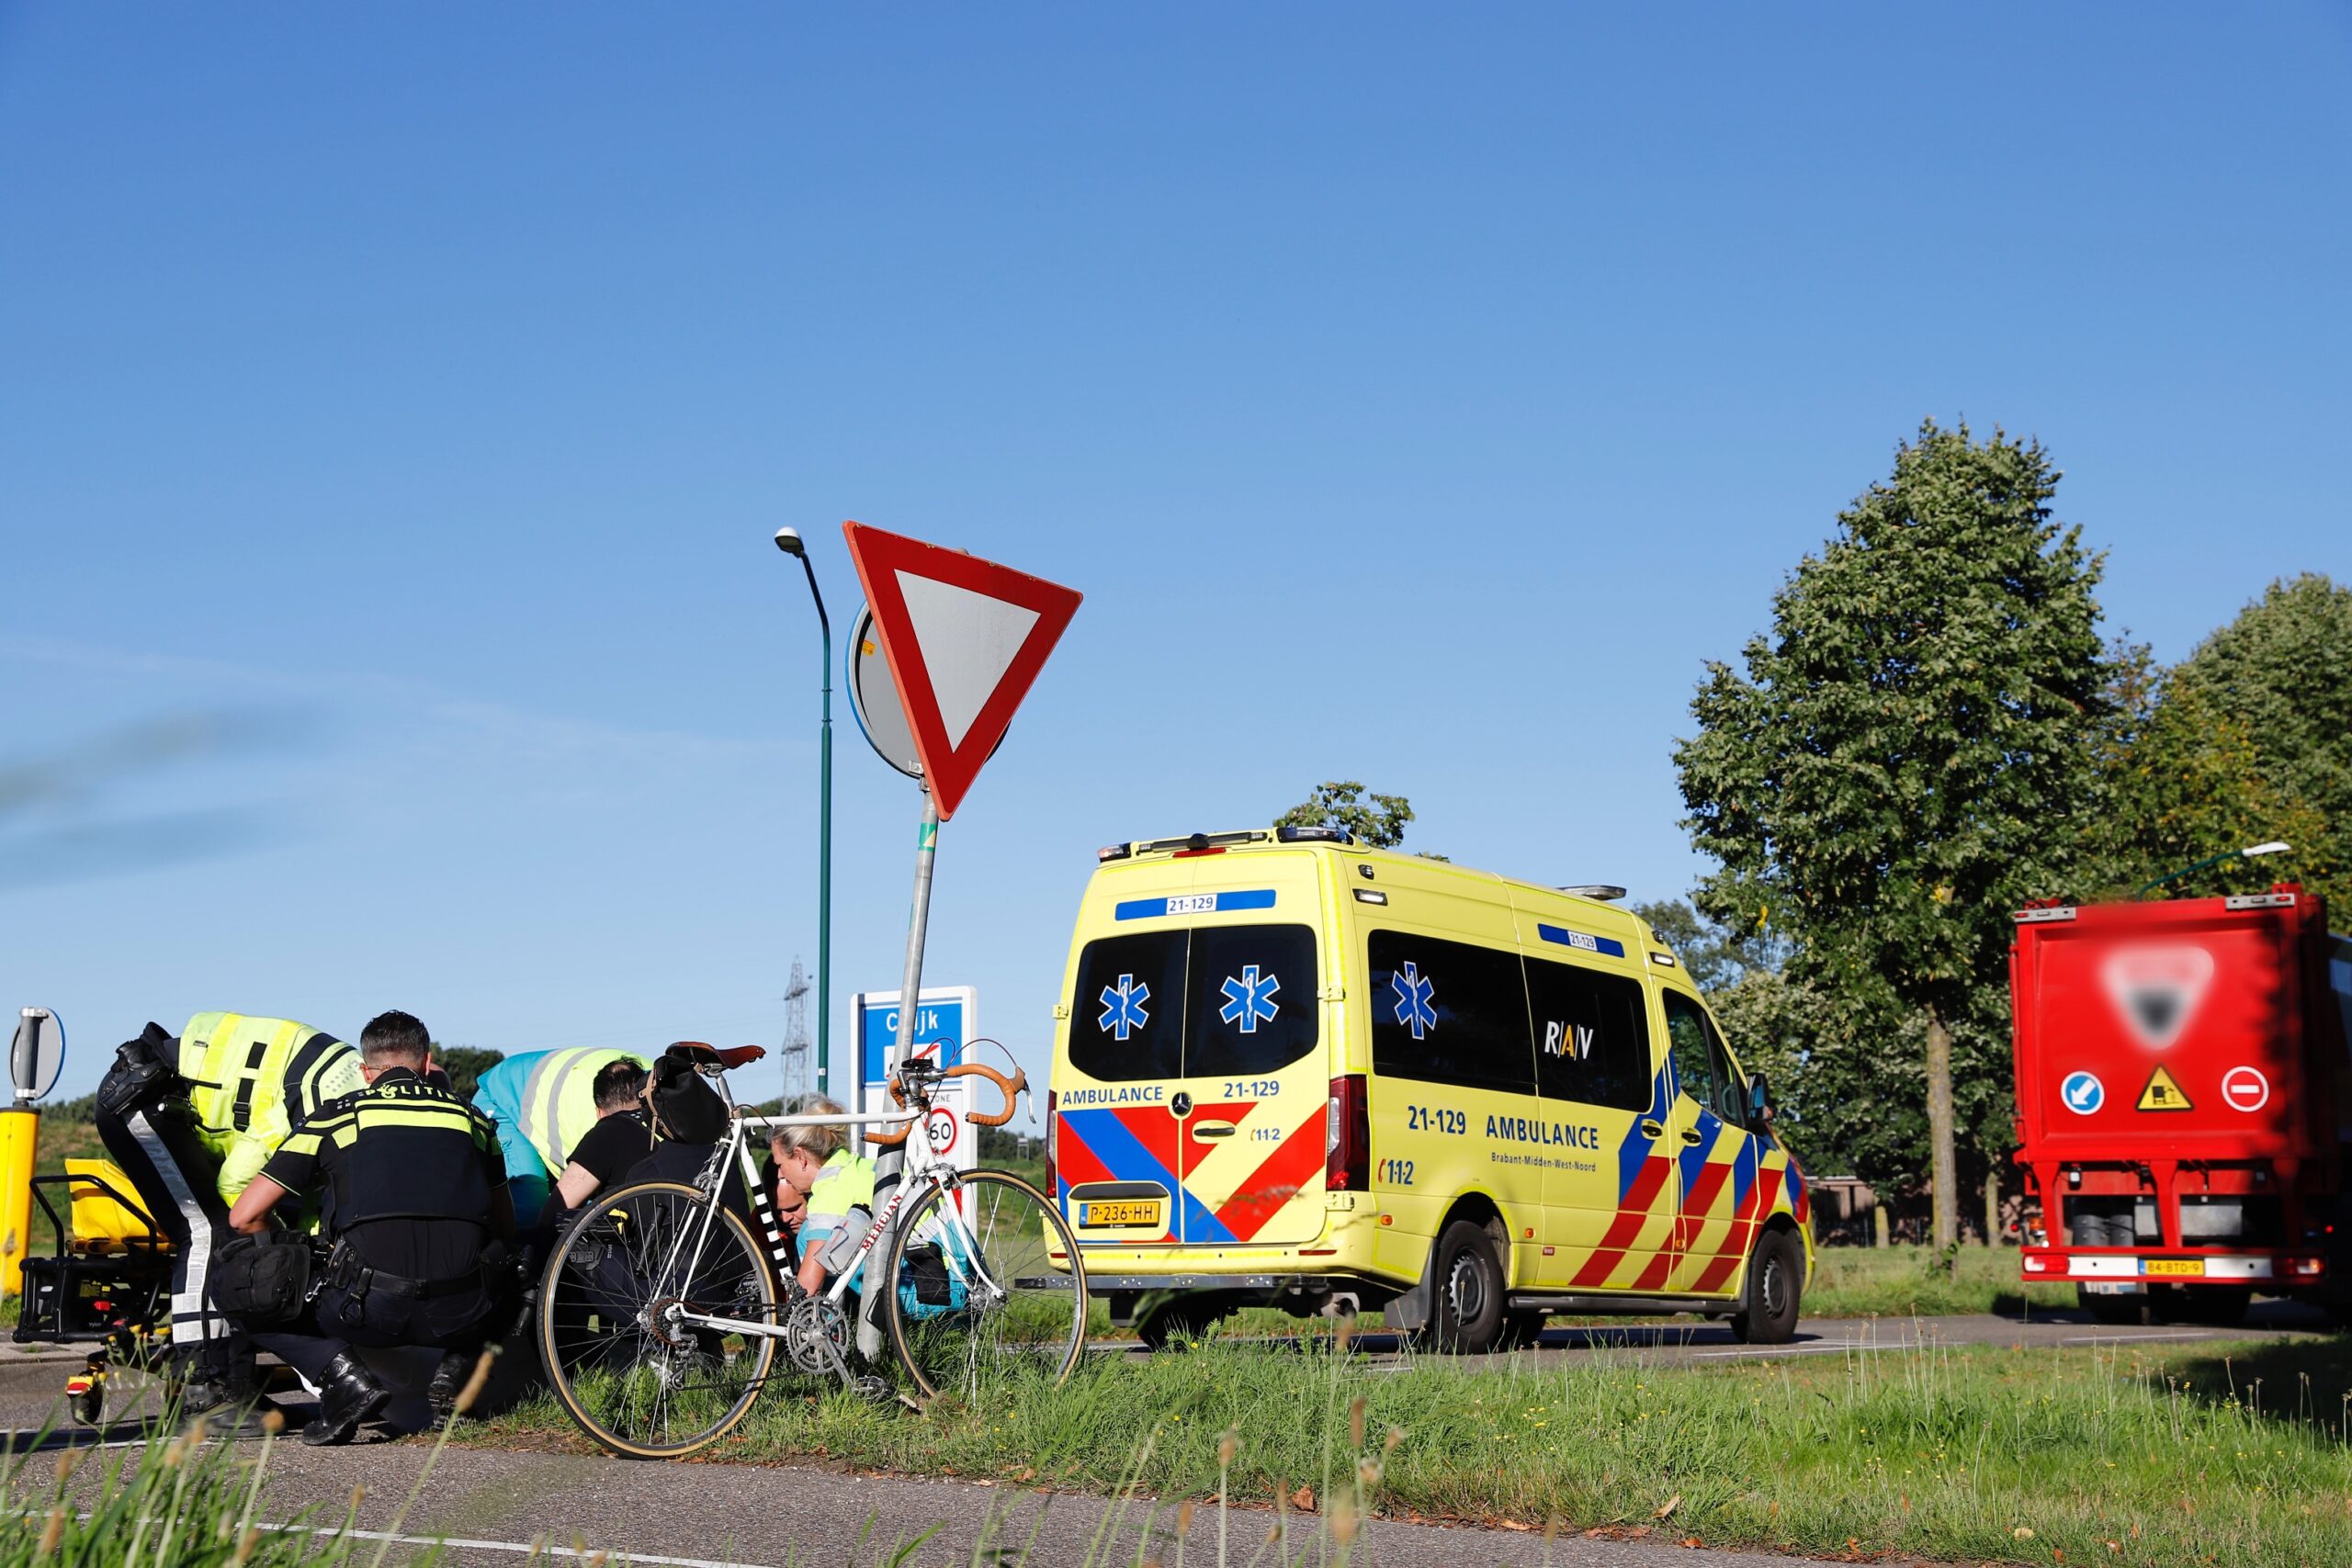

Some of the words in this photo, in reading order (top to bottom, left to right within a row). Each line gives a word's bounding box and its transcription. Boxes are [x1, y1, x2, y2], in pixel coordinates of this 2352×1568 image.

[1169, 897, 1214, 911] 21-129
[1570, 933, 1595, 949] 21-129
[1062, 1086, 1163, 1105] AMBULANCE
[1224, 1080, 1280, 1098] 21-129
[929, 1122, 951, 1140] 60
[1408, 1105, 1466, 1135] 21-129
[1486, 1114, 1600, 1150] AMBULANCE
[861, 1194, 903, 1250] MERCIAN
[1091, 1204, 1153, 1222] P-236-HH
